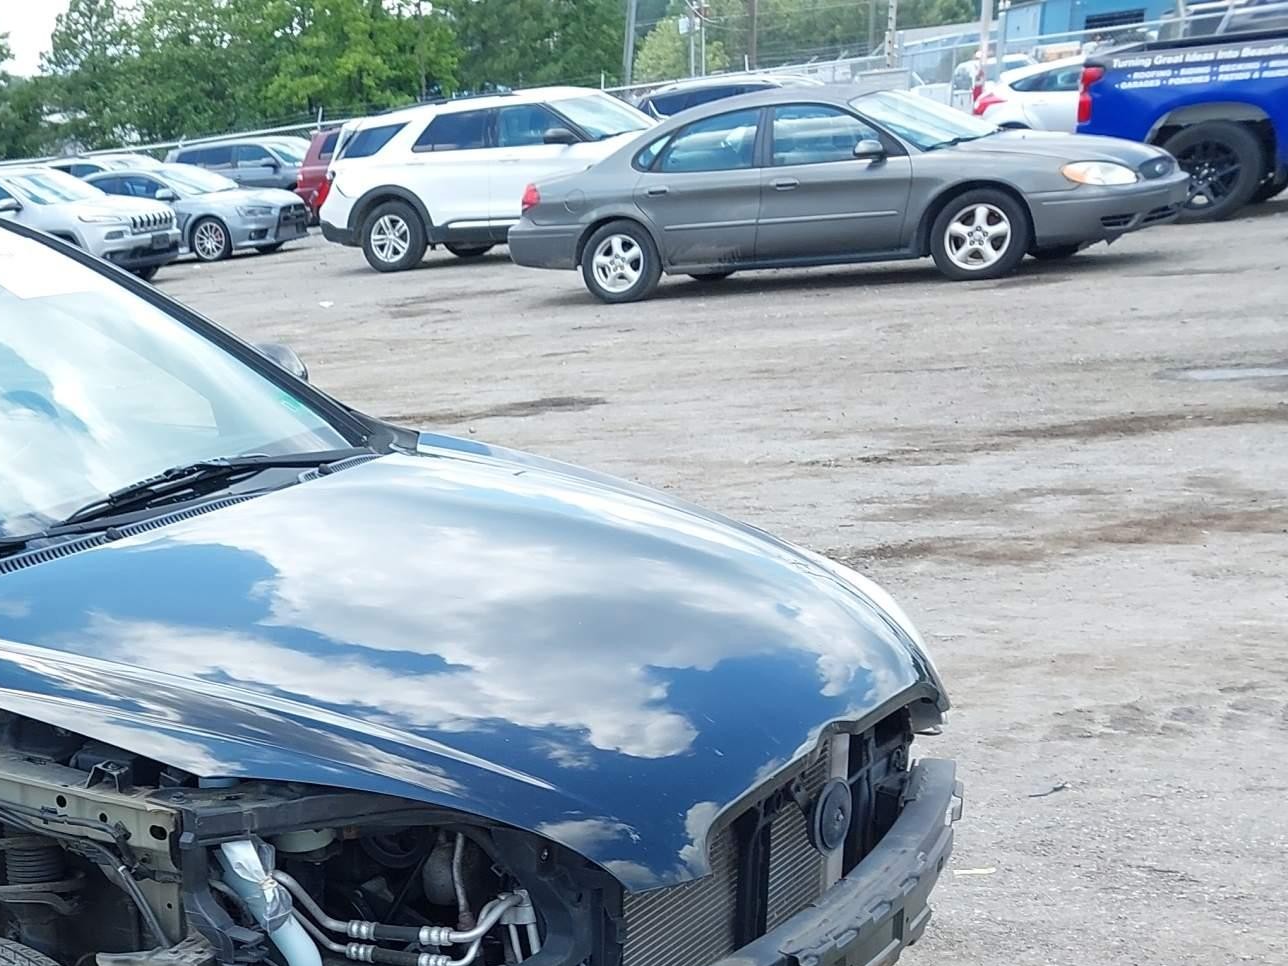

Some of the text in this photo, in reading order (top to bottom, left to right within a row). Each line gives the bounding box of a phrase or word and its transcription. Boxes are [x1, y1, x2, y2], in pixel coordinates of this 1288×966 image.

[1113, 57, 1152, 68] Turning
[1154, 55, 1185, 66] Great
[1217, 48, 1240, 60] Into
[1133, 69, 1172, 79] ROOFING
